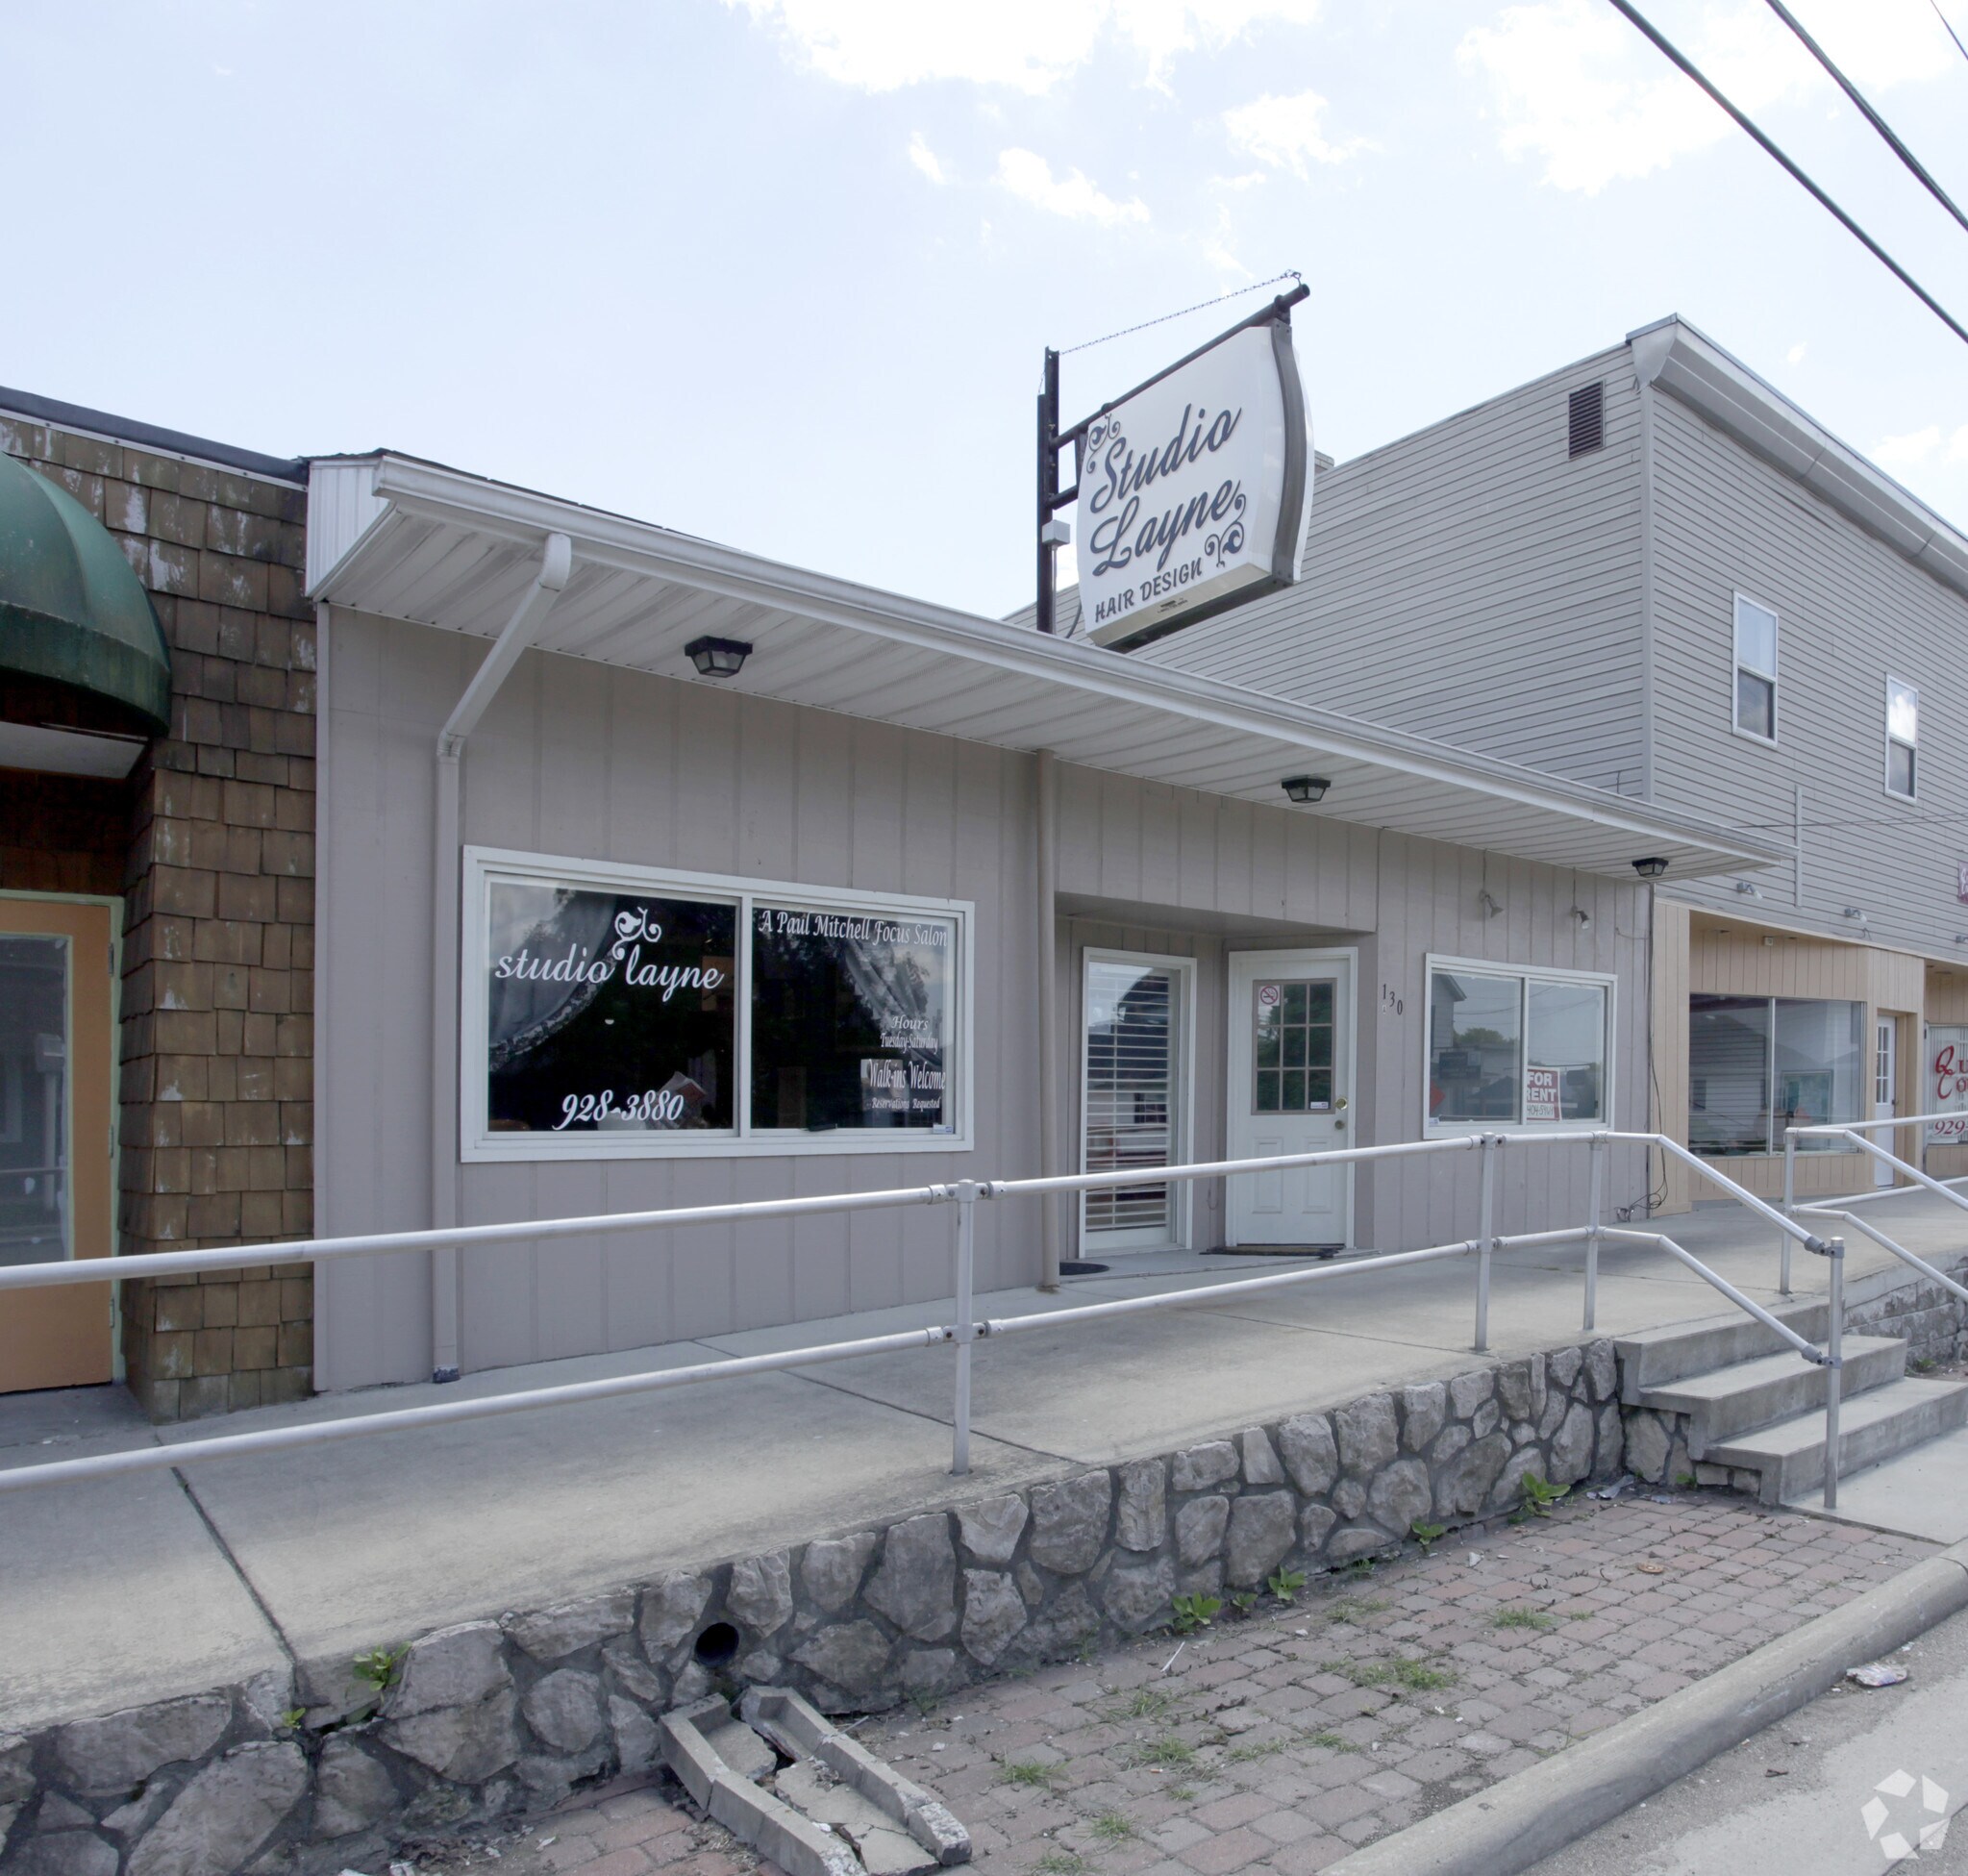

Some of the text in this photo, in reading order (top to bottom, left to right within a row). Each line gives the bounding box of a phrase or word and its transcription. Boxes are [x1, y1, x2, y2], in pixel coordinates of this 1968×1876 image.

[1090, 403, 1241, 513] Studio
[1090, 480, 1241, 577] Layne
[1095, 588, 1134, 623] HAIR
[1141, 557, 1203, 602] DESIGN
[758, 910, 947, 947] A Paul Mitchell Focus Salon
[495, 943, 725, 1002] studio layne
[1383, 983, 1404, 1015] 130
[890, 1014, 929, 1031] Hours
[881, 1032, 938, 1055] Tuesday-Saturday
[909, 1061, 946, 1090] Welcome
[1527, 1071, 1553, 1087] FOR
[552, 1089, 684, 1131] 928-3880
[872, 1097, 941, 1112] Reservations Requested
